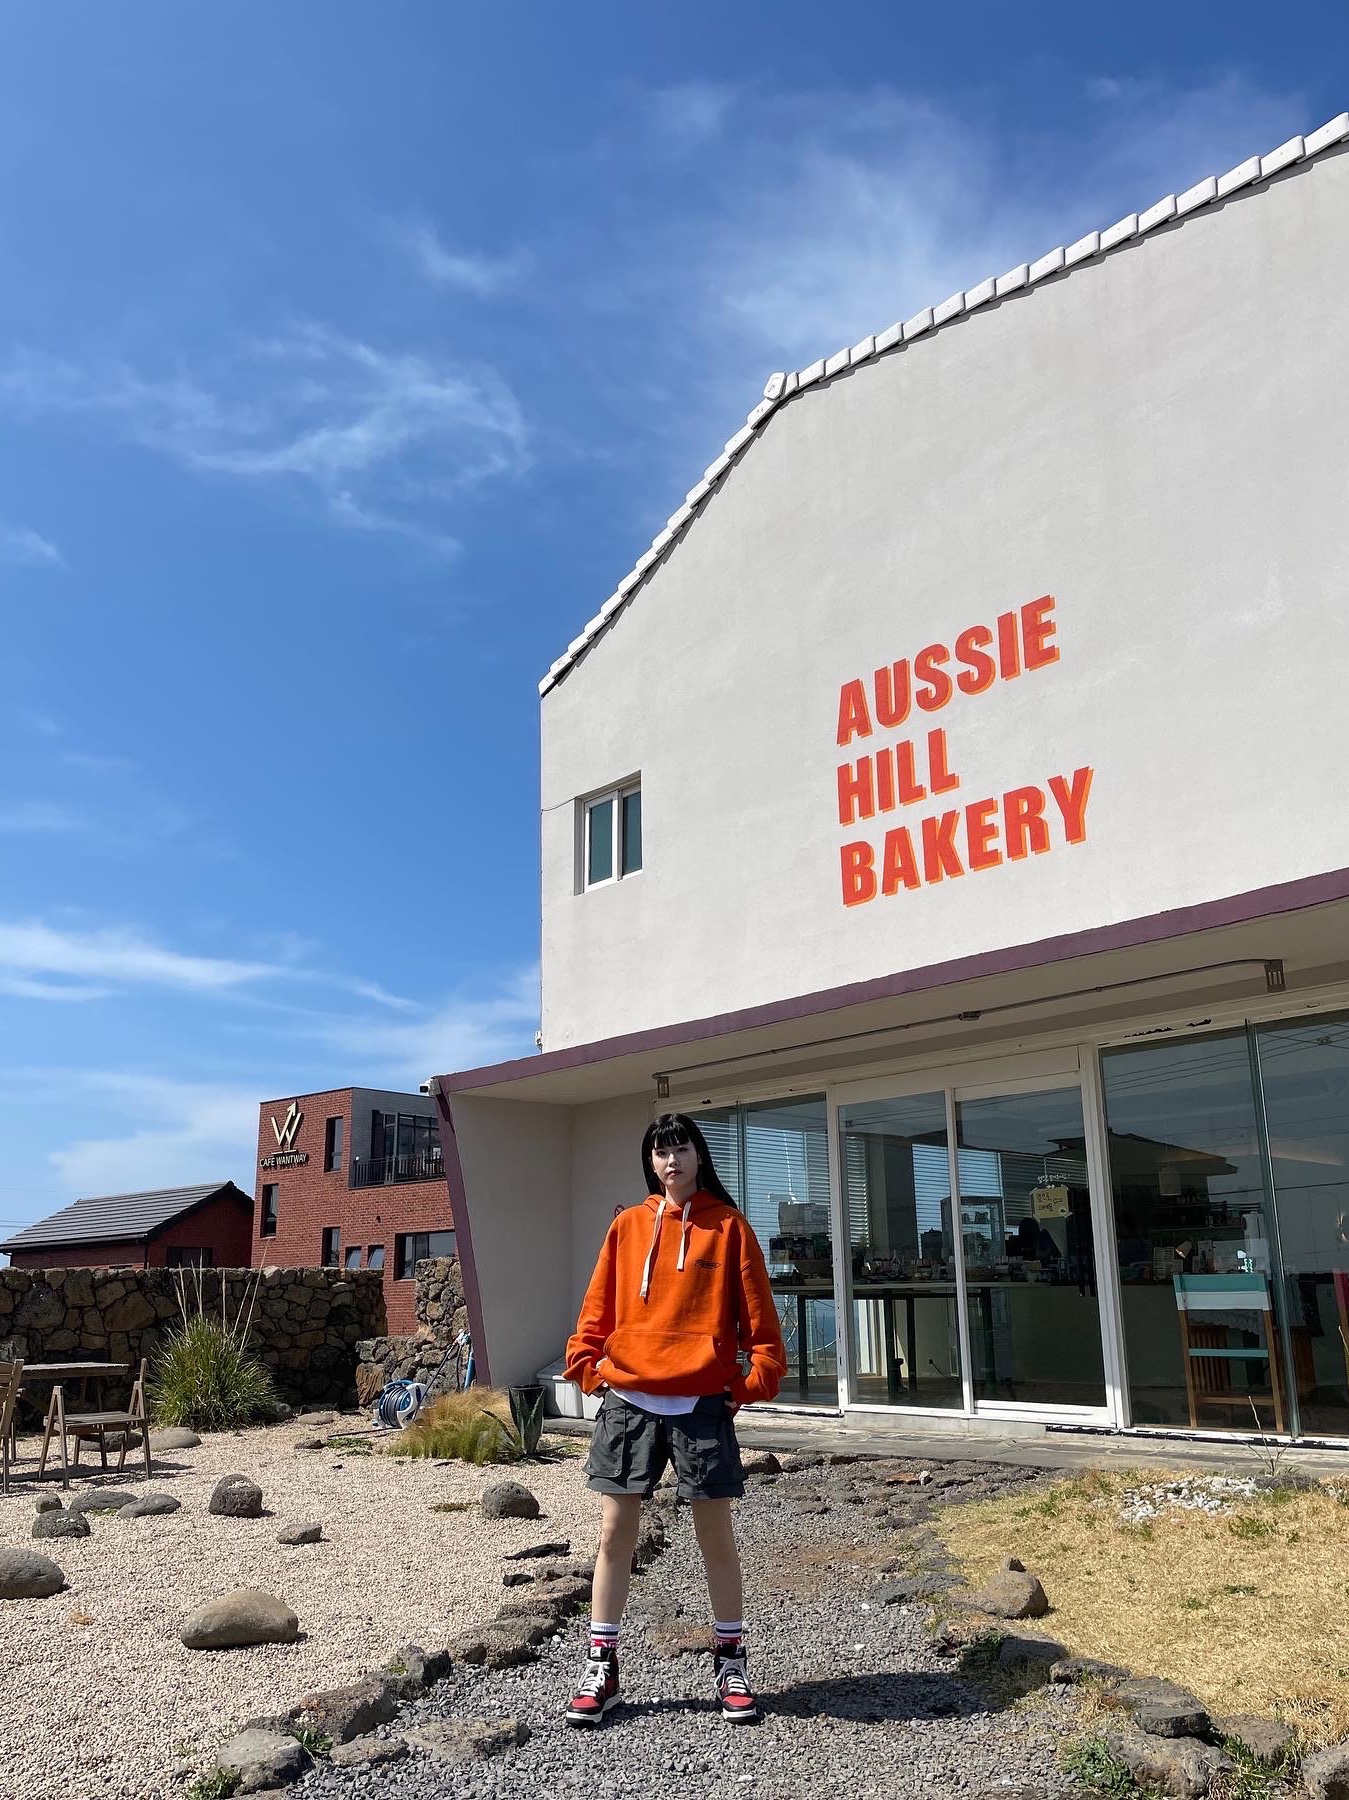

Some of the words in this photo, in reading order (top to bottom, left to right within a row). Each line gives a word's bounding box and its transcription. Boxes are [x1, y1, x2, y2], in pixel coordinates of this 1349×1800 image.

[836, 594, 1060, 746] AUSSIE
[836, 728, 960, 826] HILL
[840, 766, 1094, 908] BAKERY
[259, 1157, 276, 1167] CAFE
[276, 1154, 308, 1165] WANTWAY
